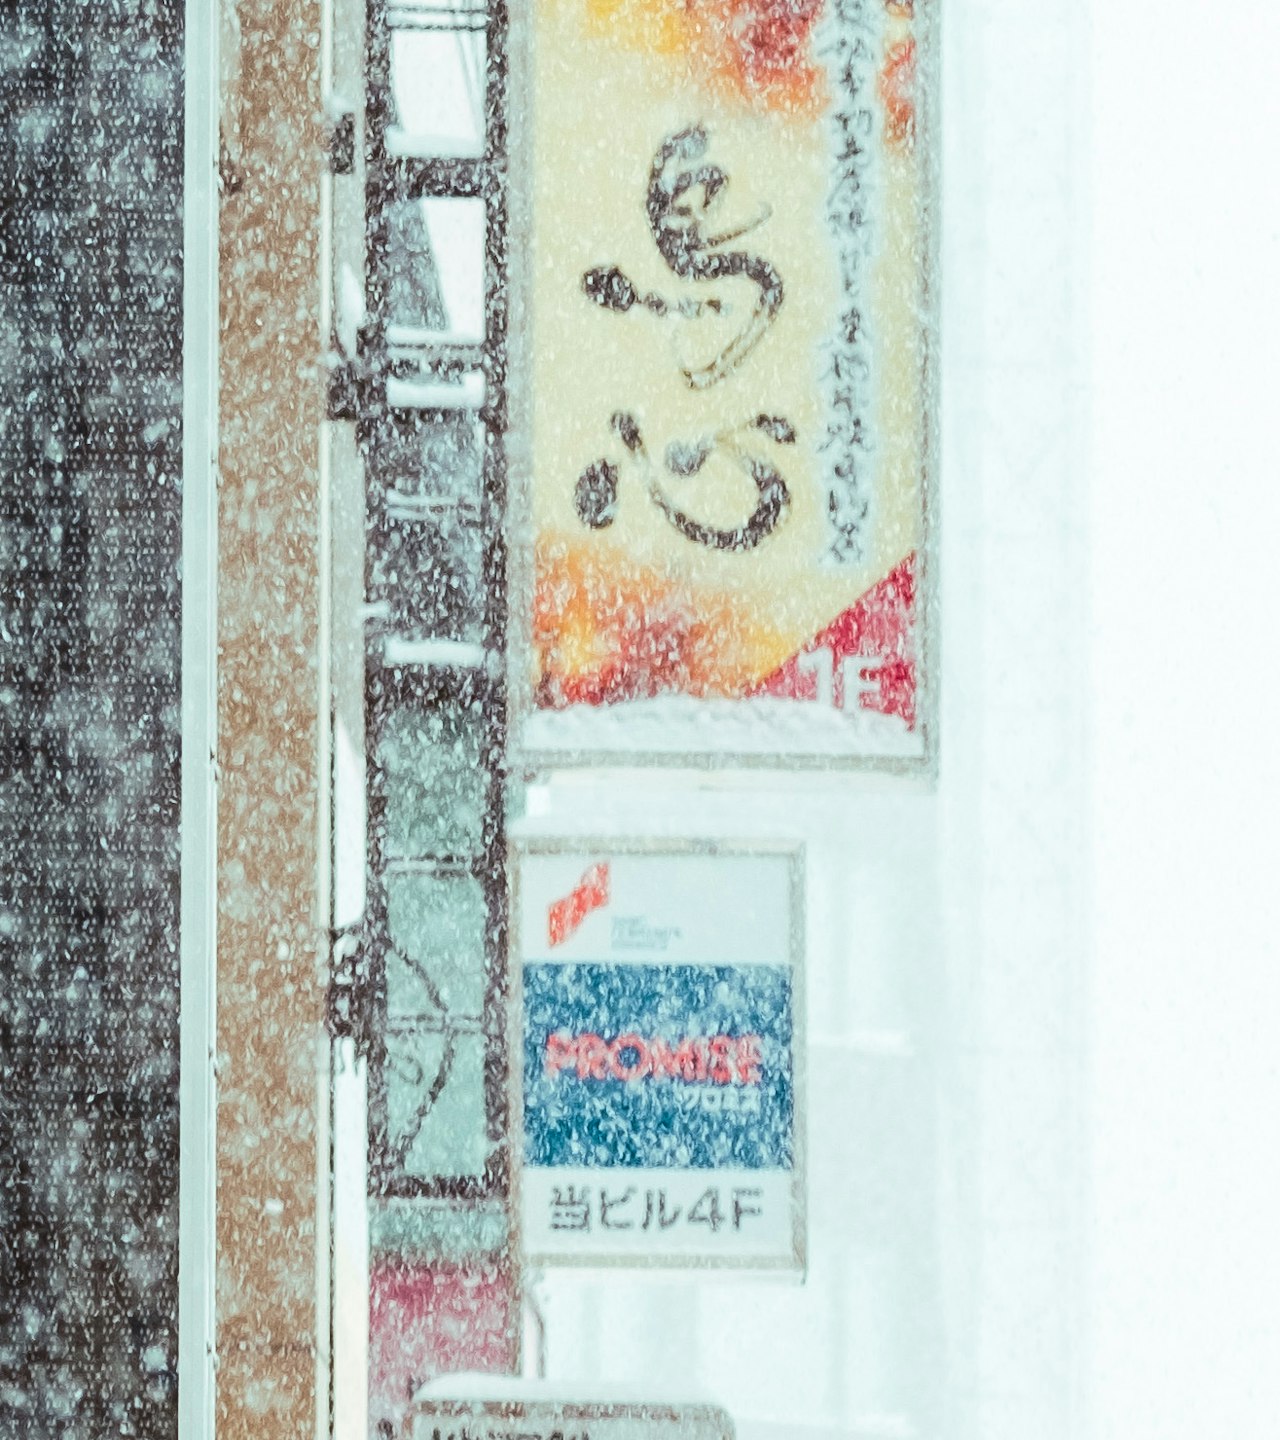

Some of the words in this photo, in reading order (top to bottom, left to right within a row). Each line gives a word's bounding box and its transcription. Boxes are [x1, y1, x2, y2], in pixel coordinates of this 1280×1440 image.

[546, 1031, 762, 1085] PROMISE
[549, 1184, 763, 1233] 当ビル4F
